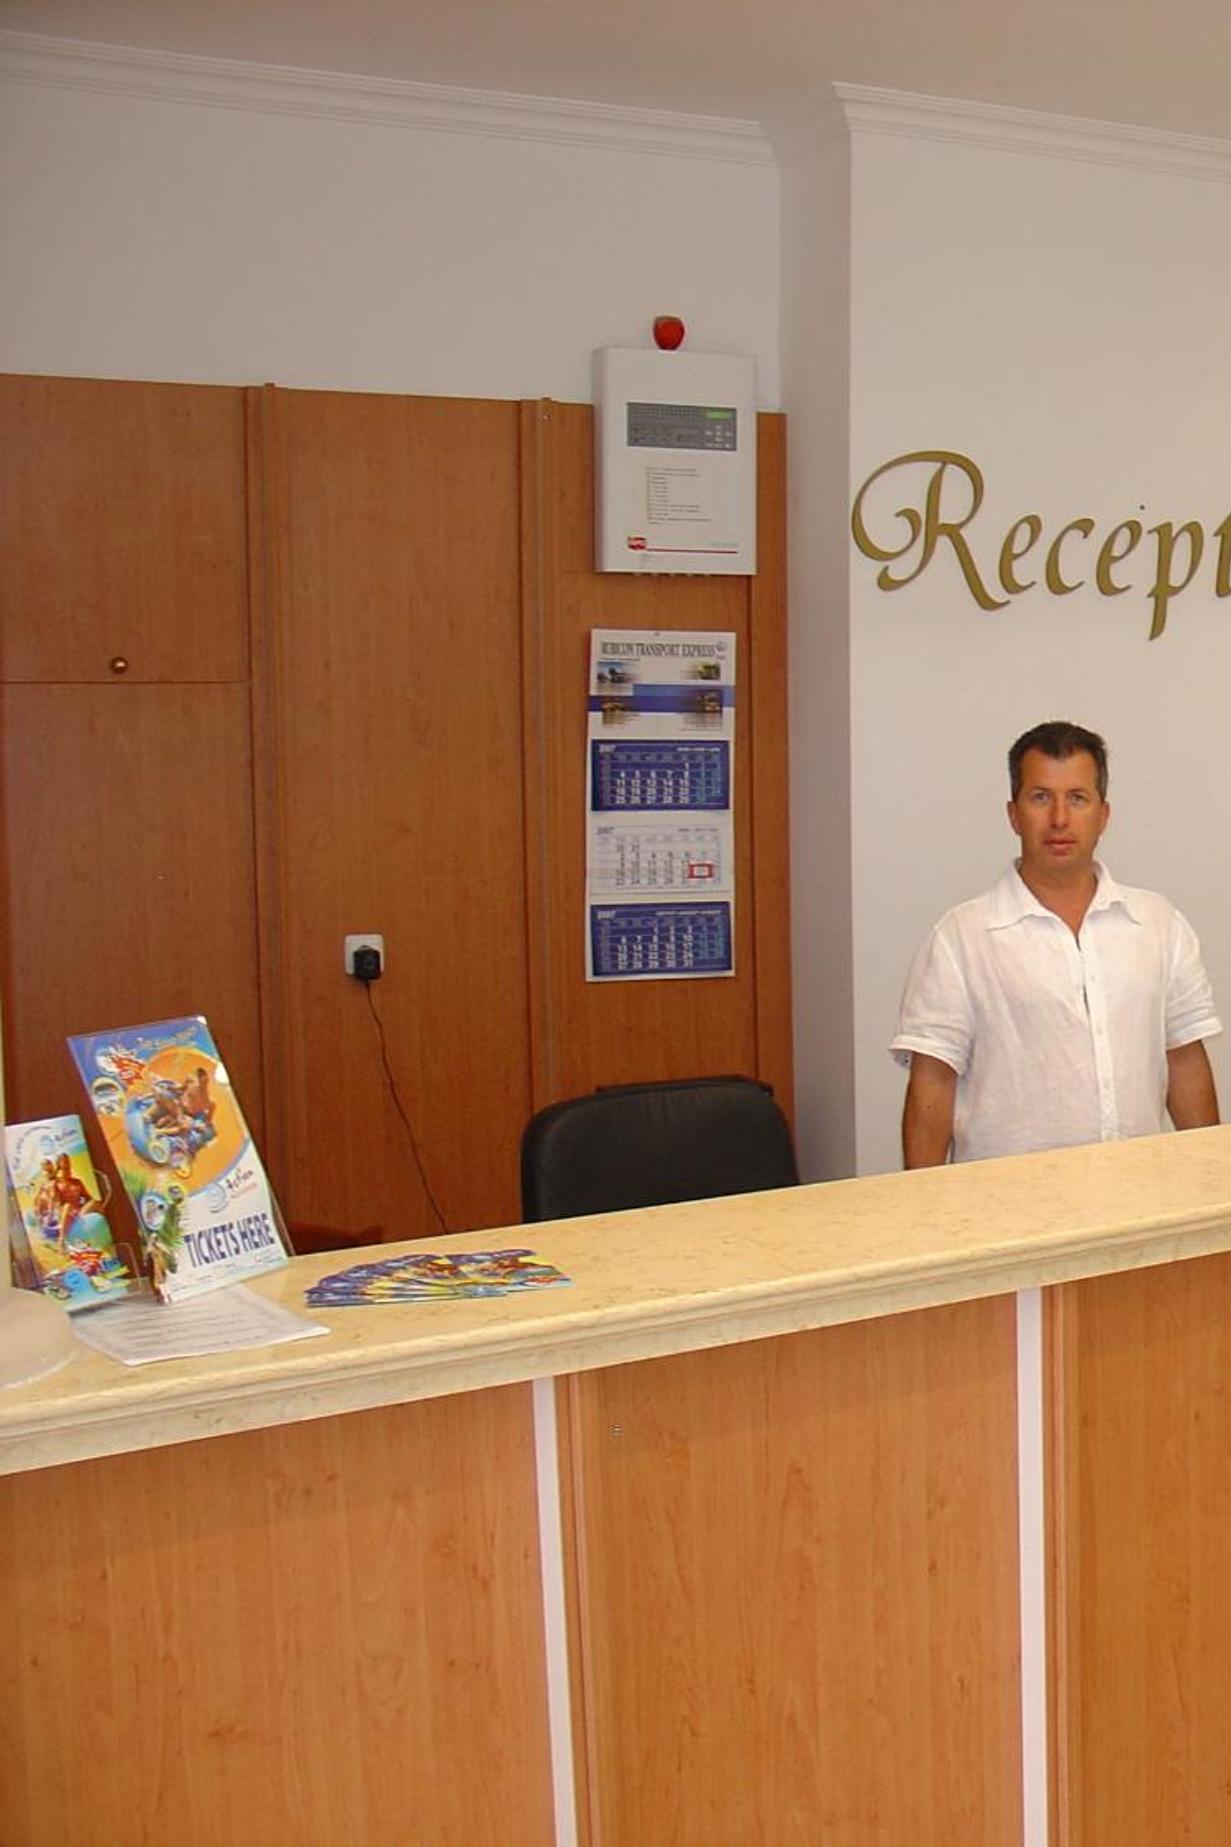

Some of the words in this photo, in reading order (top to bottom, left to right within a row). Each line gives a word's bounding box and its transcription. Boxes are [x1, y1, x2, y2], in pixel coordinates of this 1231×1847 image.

[636, 642, 680, 657] TRANSPORT
[183, 1222, 241, 1268] TICKETS
[236, 1213, 275, 1252] HERE
